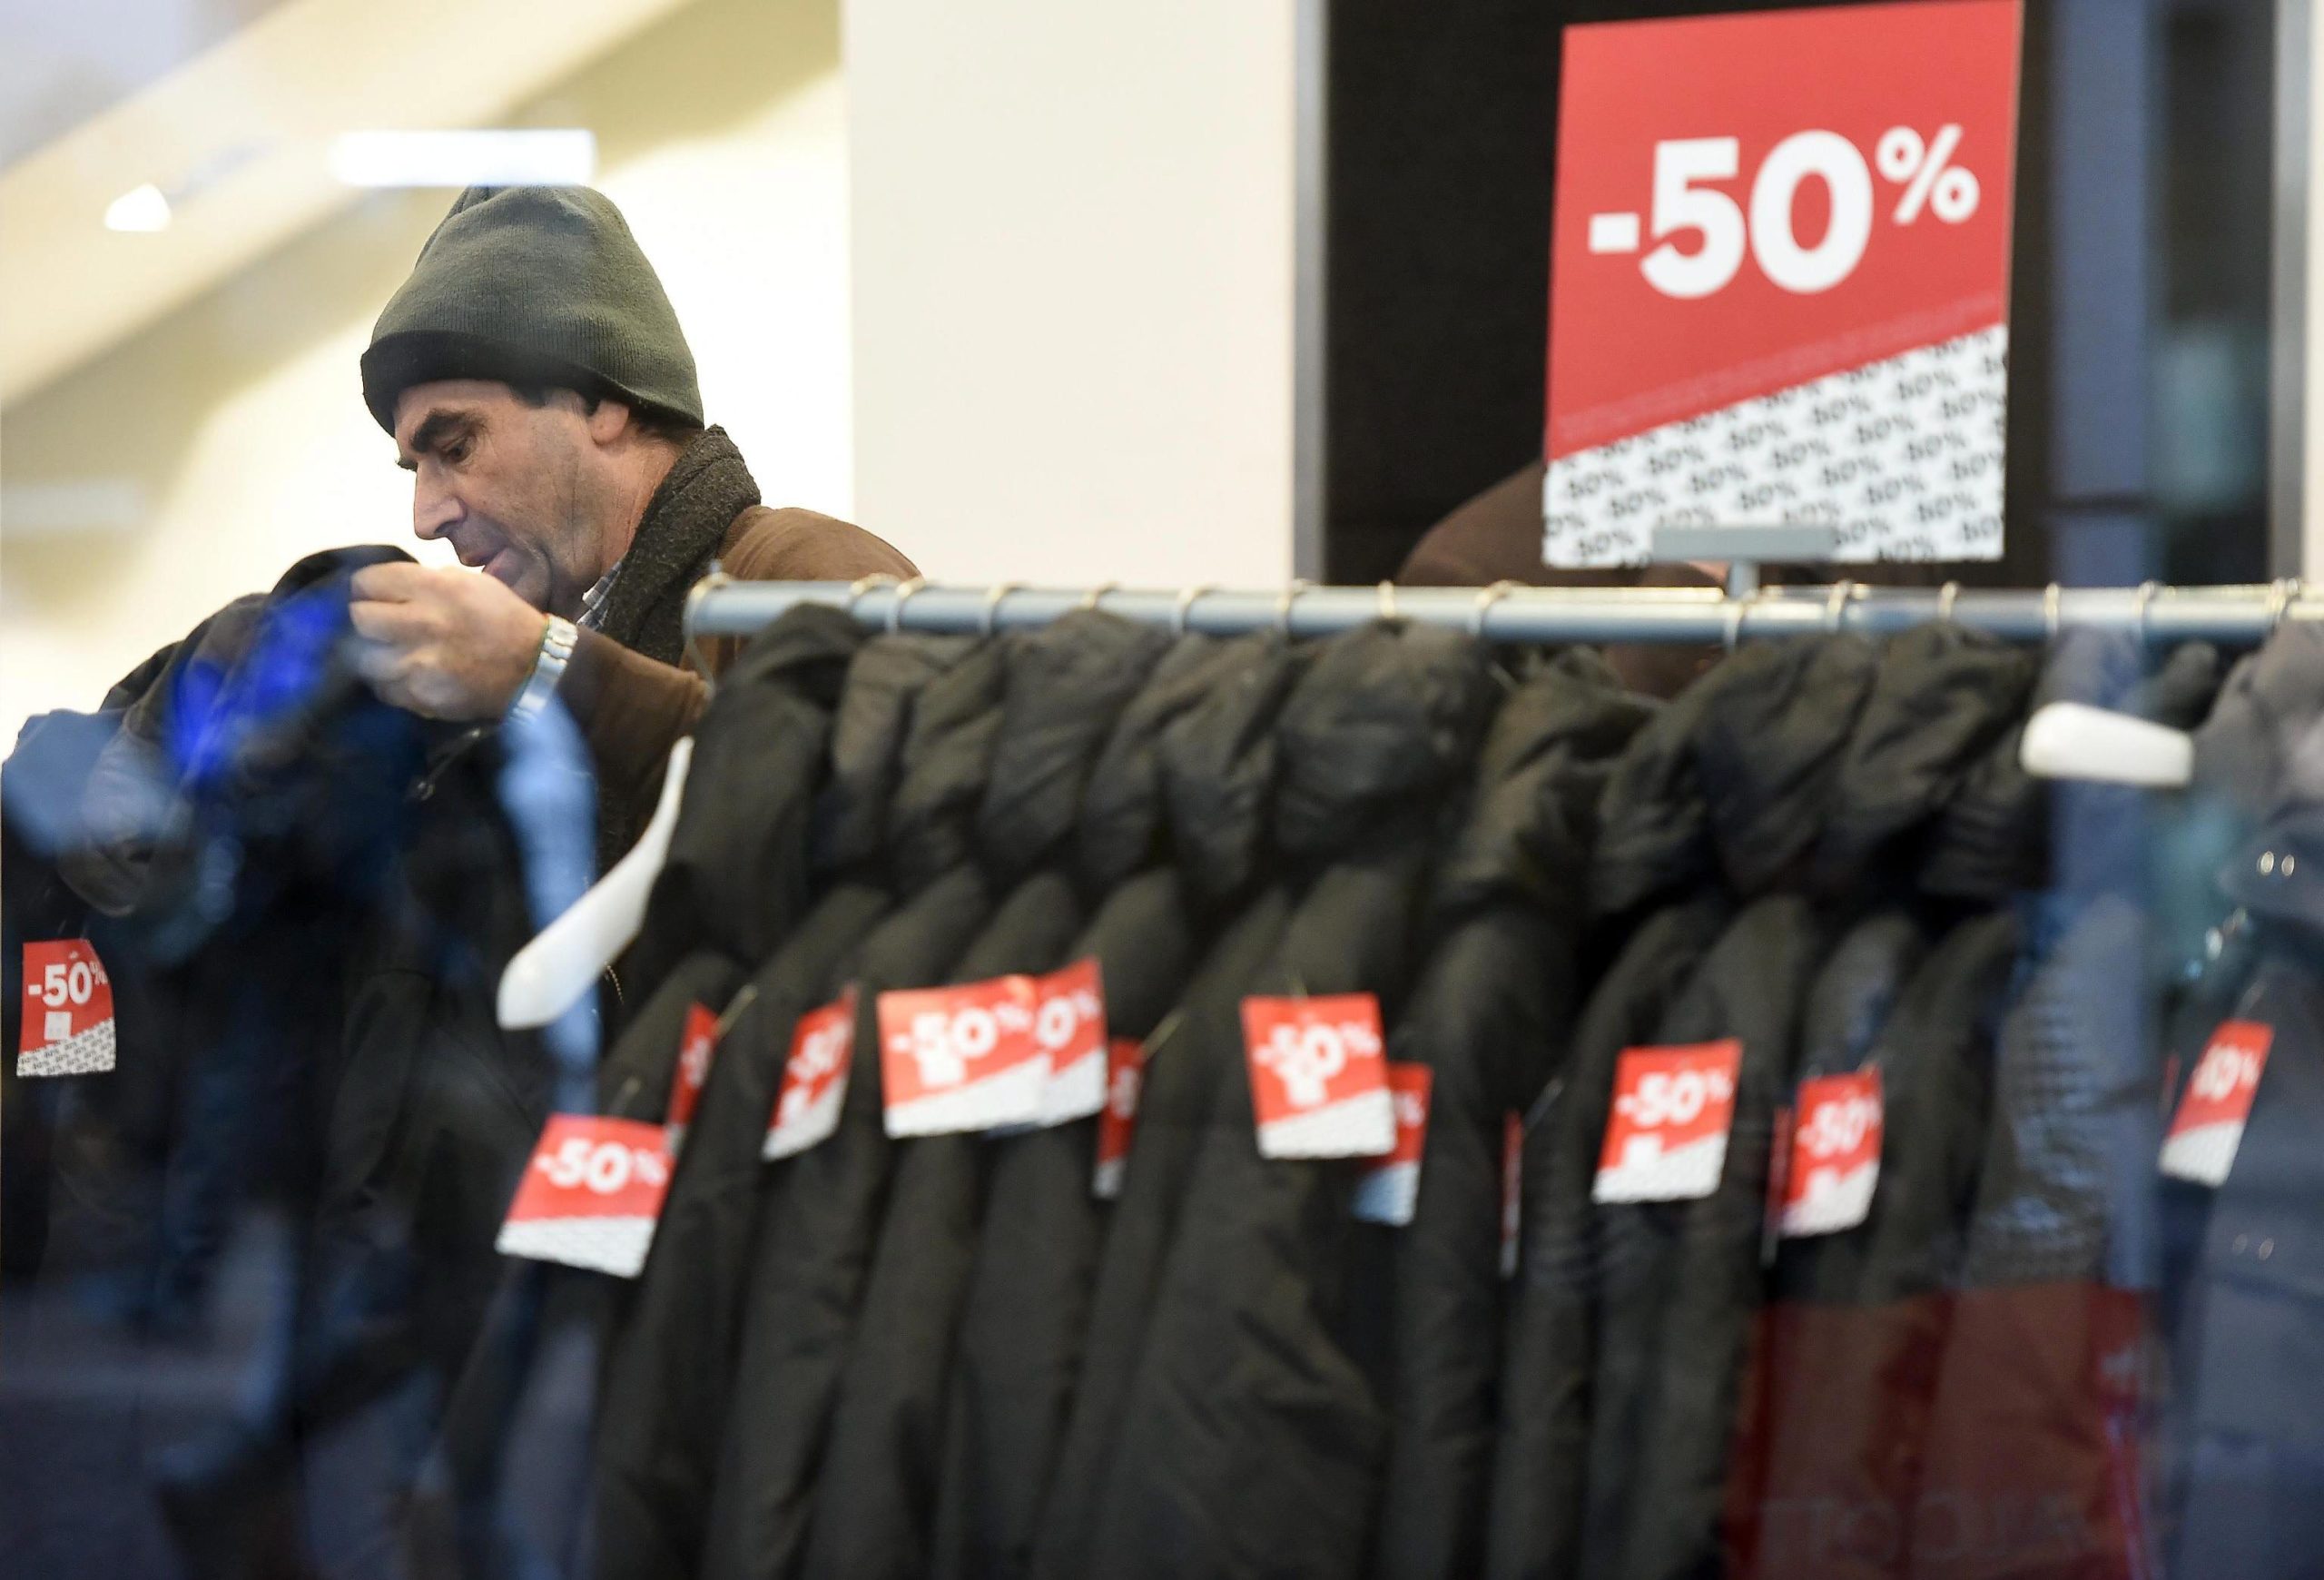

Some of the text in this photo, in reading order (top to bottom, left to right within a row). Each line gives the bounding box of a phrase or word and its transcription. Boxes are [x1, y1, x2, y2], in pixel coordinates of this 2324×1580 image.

[1589, 123, 1980, 298] -50%
[28, 960, 108, 1007] -50%
[1615, 1067, 1735, 1128] -50%
[534, 1137, 669, 1195] -50%
